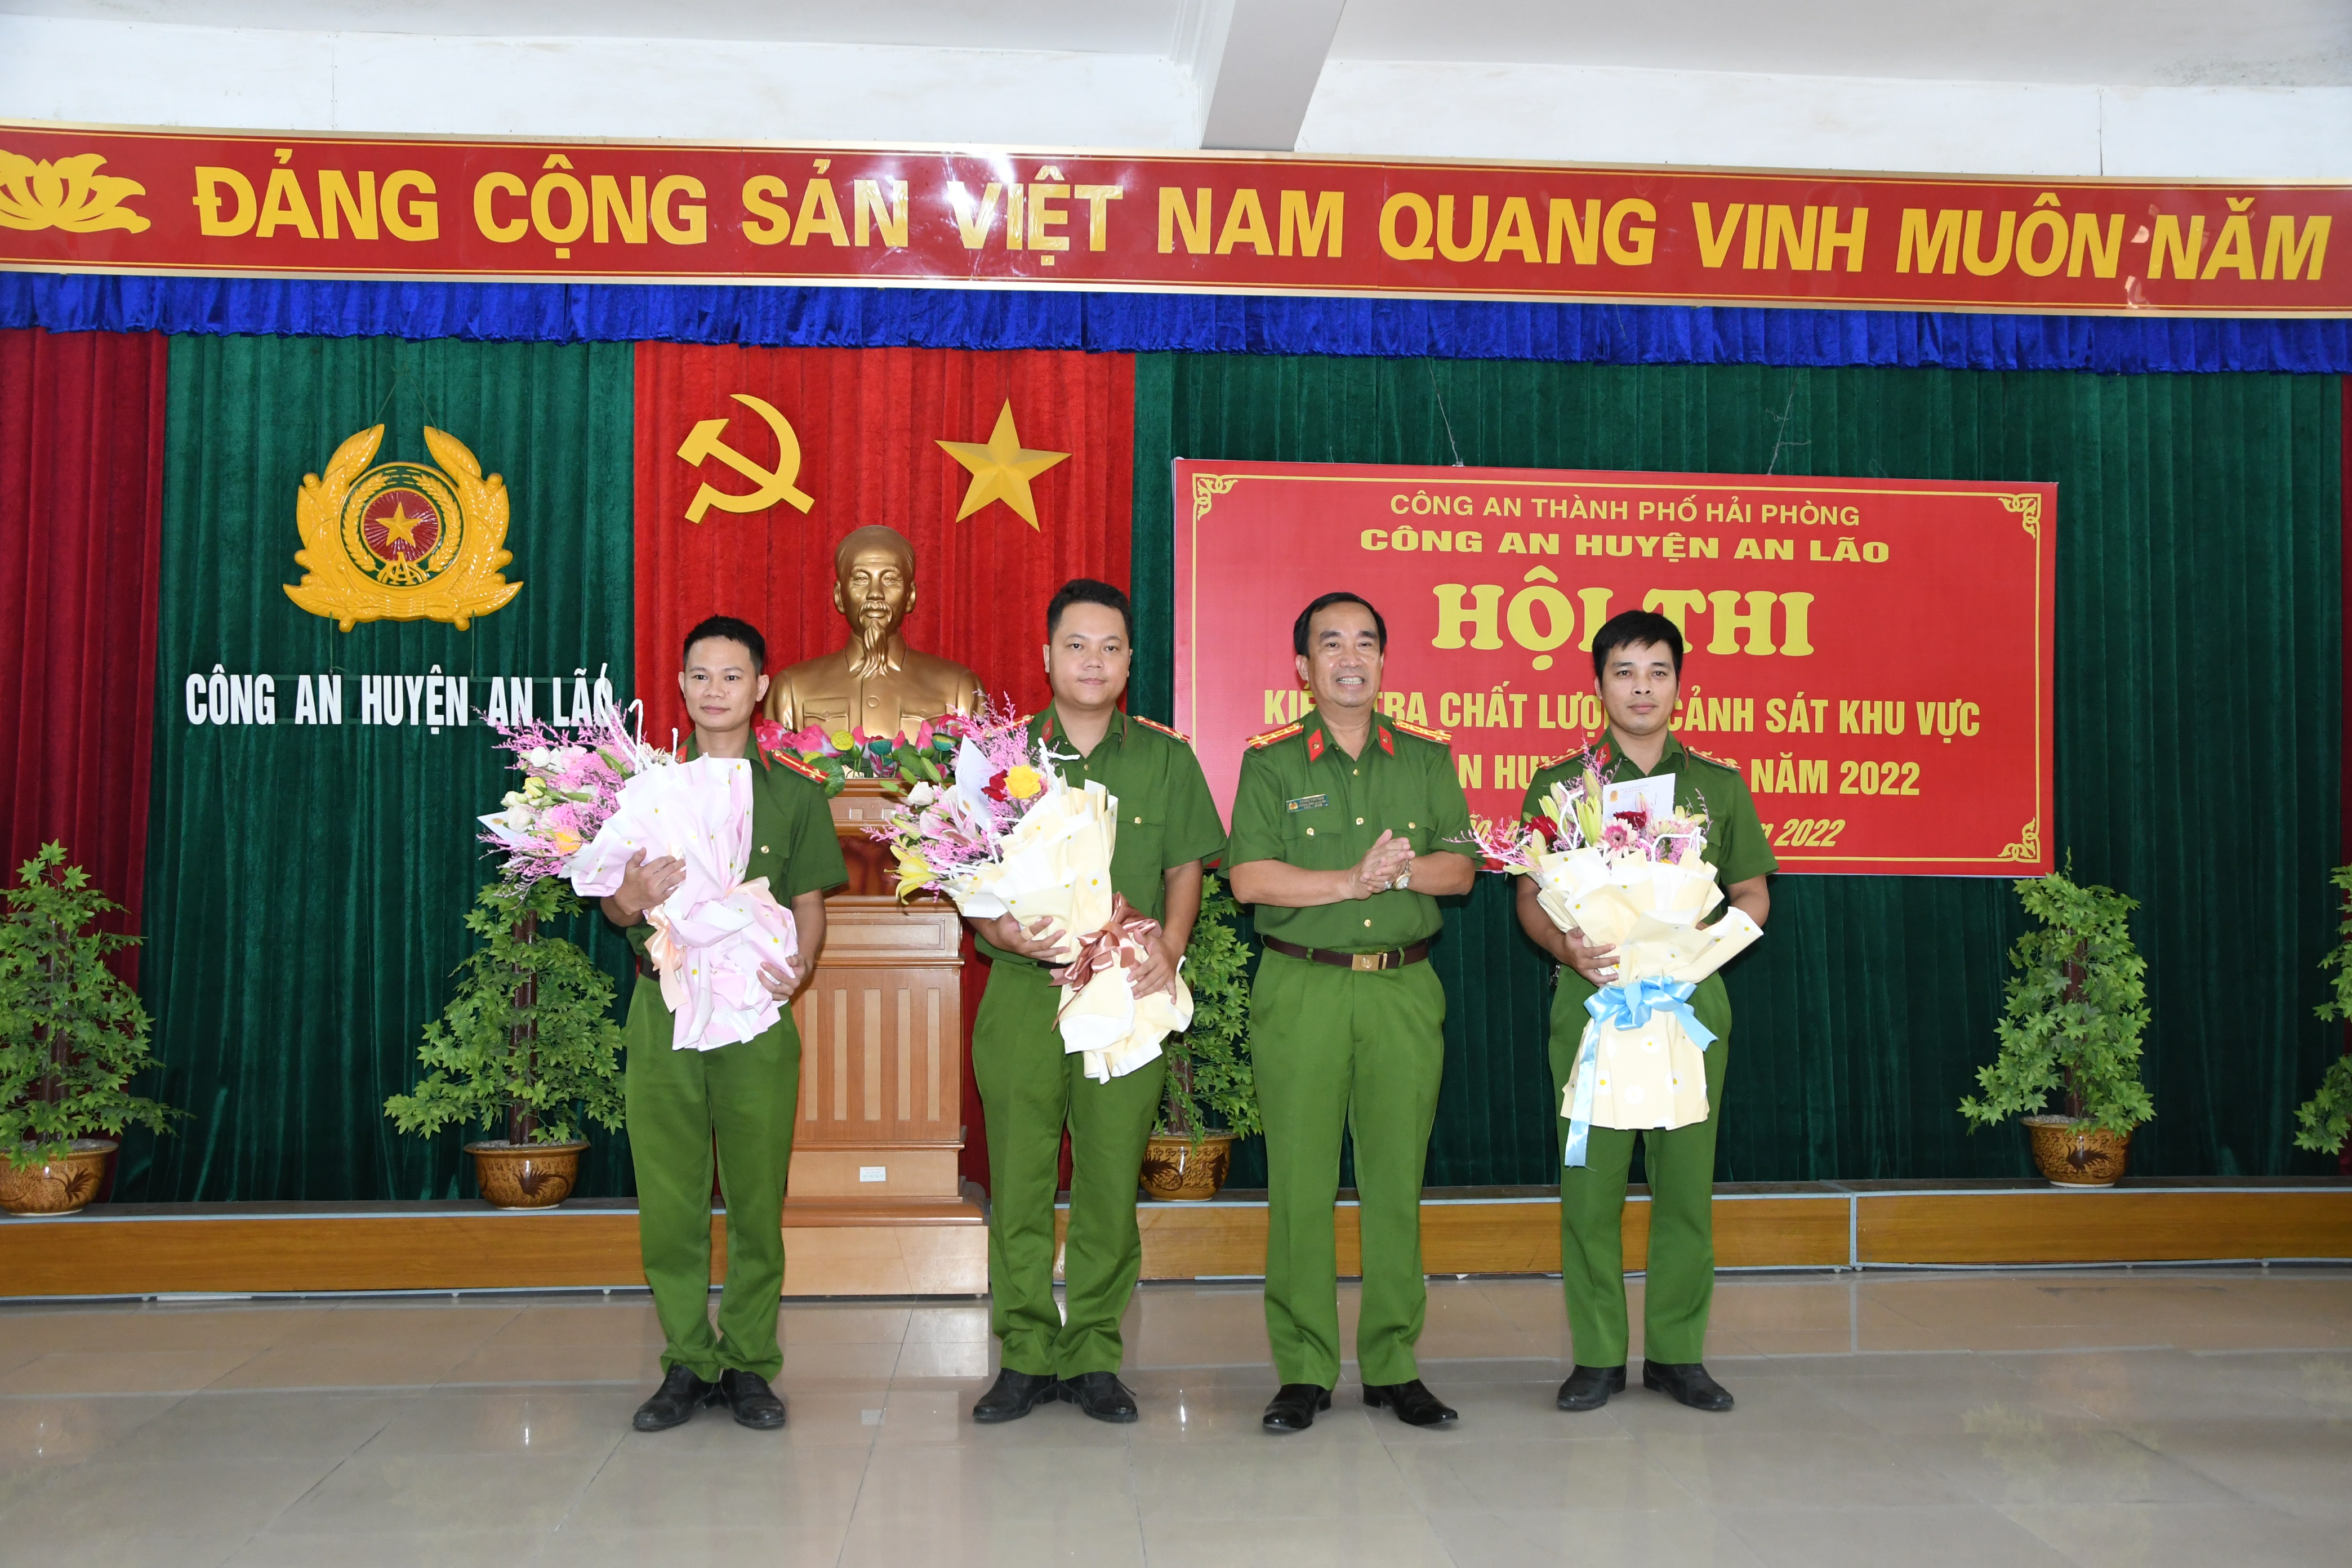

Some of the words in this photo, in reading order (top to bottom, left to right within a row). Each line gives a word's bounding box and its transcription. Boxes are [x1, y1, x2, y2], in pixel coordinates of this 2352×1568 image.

[193, 149, 439, 242] ĐẢNG
[473, 154, 707, 259] CỘNG
[742, 159, 908, 247] SẢN
[946, 165, 1123, 266] VIỆT
[1158, 187, 1344, 257] NAM
[1379, 192, 1656, 266] QUANG
[1692, 202, 1869, 272] VINH
[1896, 193, 2126, 278] MUÔN
[2147, 197, 2333, 280] NĂM
[1391, 490, 1473, 515] CÔNG
[1483, 497, 1521, 516] AN
[1531, 494, 1628, 520] THÀNH
[1639, 494, 1698, 522] PHỐ
[1707, 496, 1752, 523] HẢI
[1761, 500, 1859, 526] PHÒNG
[1361, 525, 1482, 553] CÔNG
[1498, 532, 1560, 555] AN
[1575, 532, 1719, 563] HUYỆN
[1734, 538, 1794, 560] AN
[1810, 537, 1889, 563] LÃO
[1432, 565, 1614, 671] HỘI
[1642, 588, 1815, 657] THI
[186, 663, 276, 725] CÔNG
[295, 674, 342, 725] AN
[362, 665, 468, 734] HUYỆN
[487, 676, 533, 727] AN
[553, 668, 613, 727] LÃO
[1440, 681, 1527, 728] CHẤT
[1539, 691, 1609, 737] LƯỢ
[1766, 692, 1829, 733] SÁT
[1839, 700, 1905, 735] KHU
[1917, 698, 1980, 743] VỰC
[1751, 752, 1828, 794] NĂM
[1839, 760, 1921, 795] 2022
[1774, 818, 1846, 847] 2022
